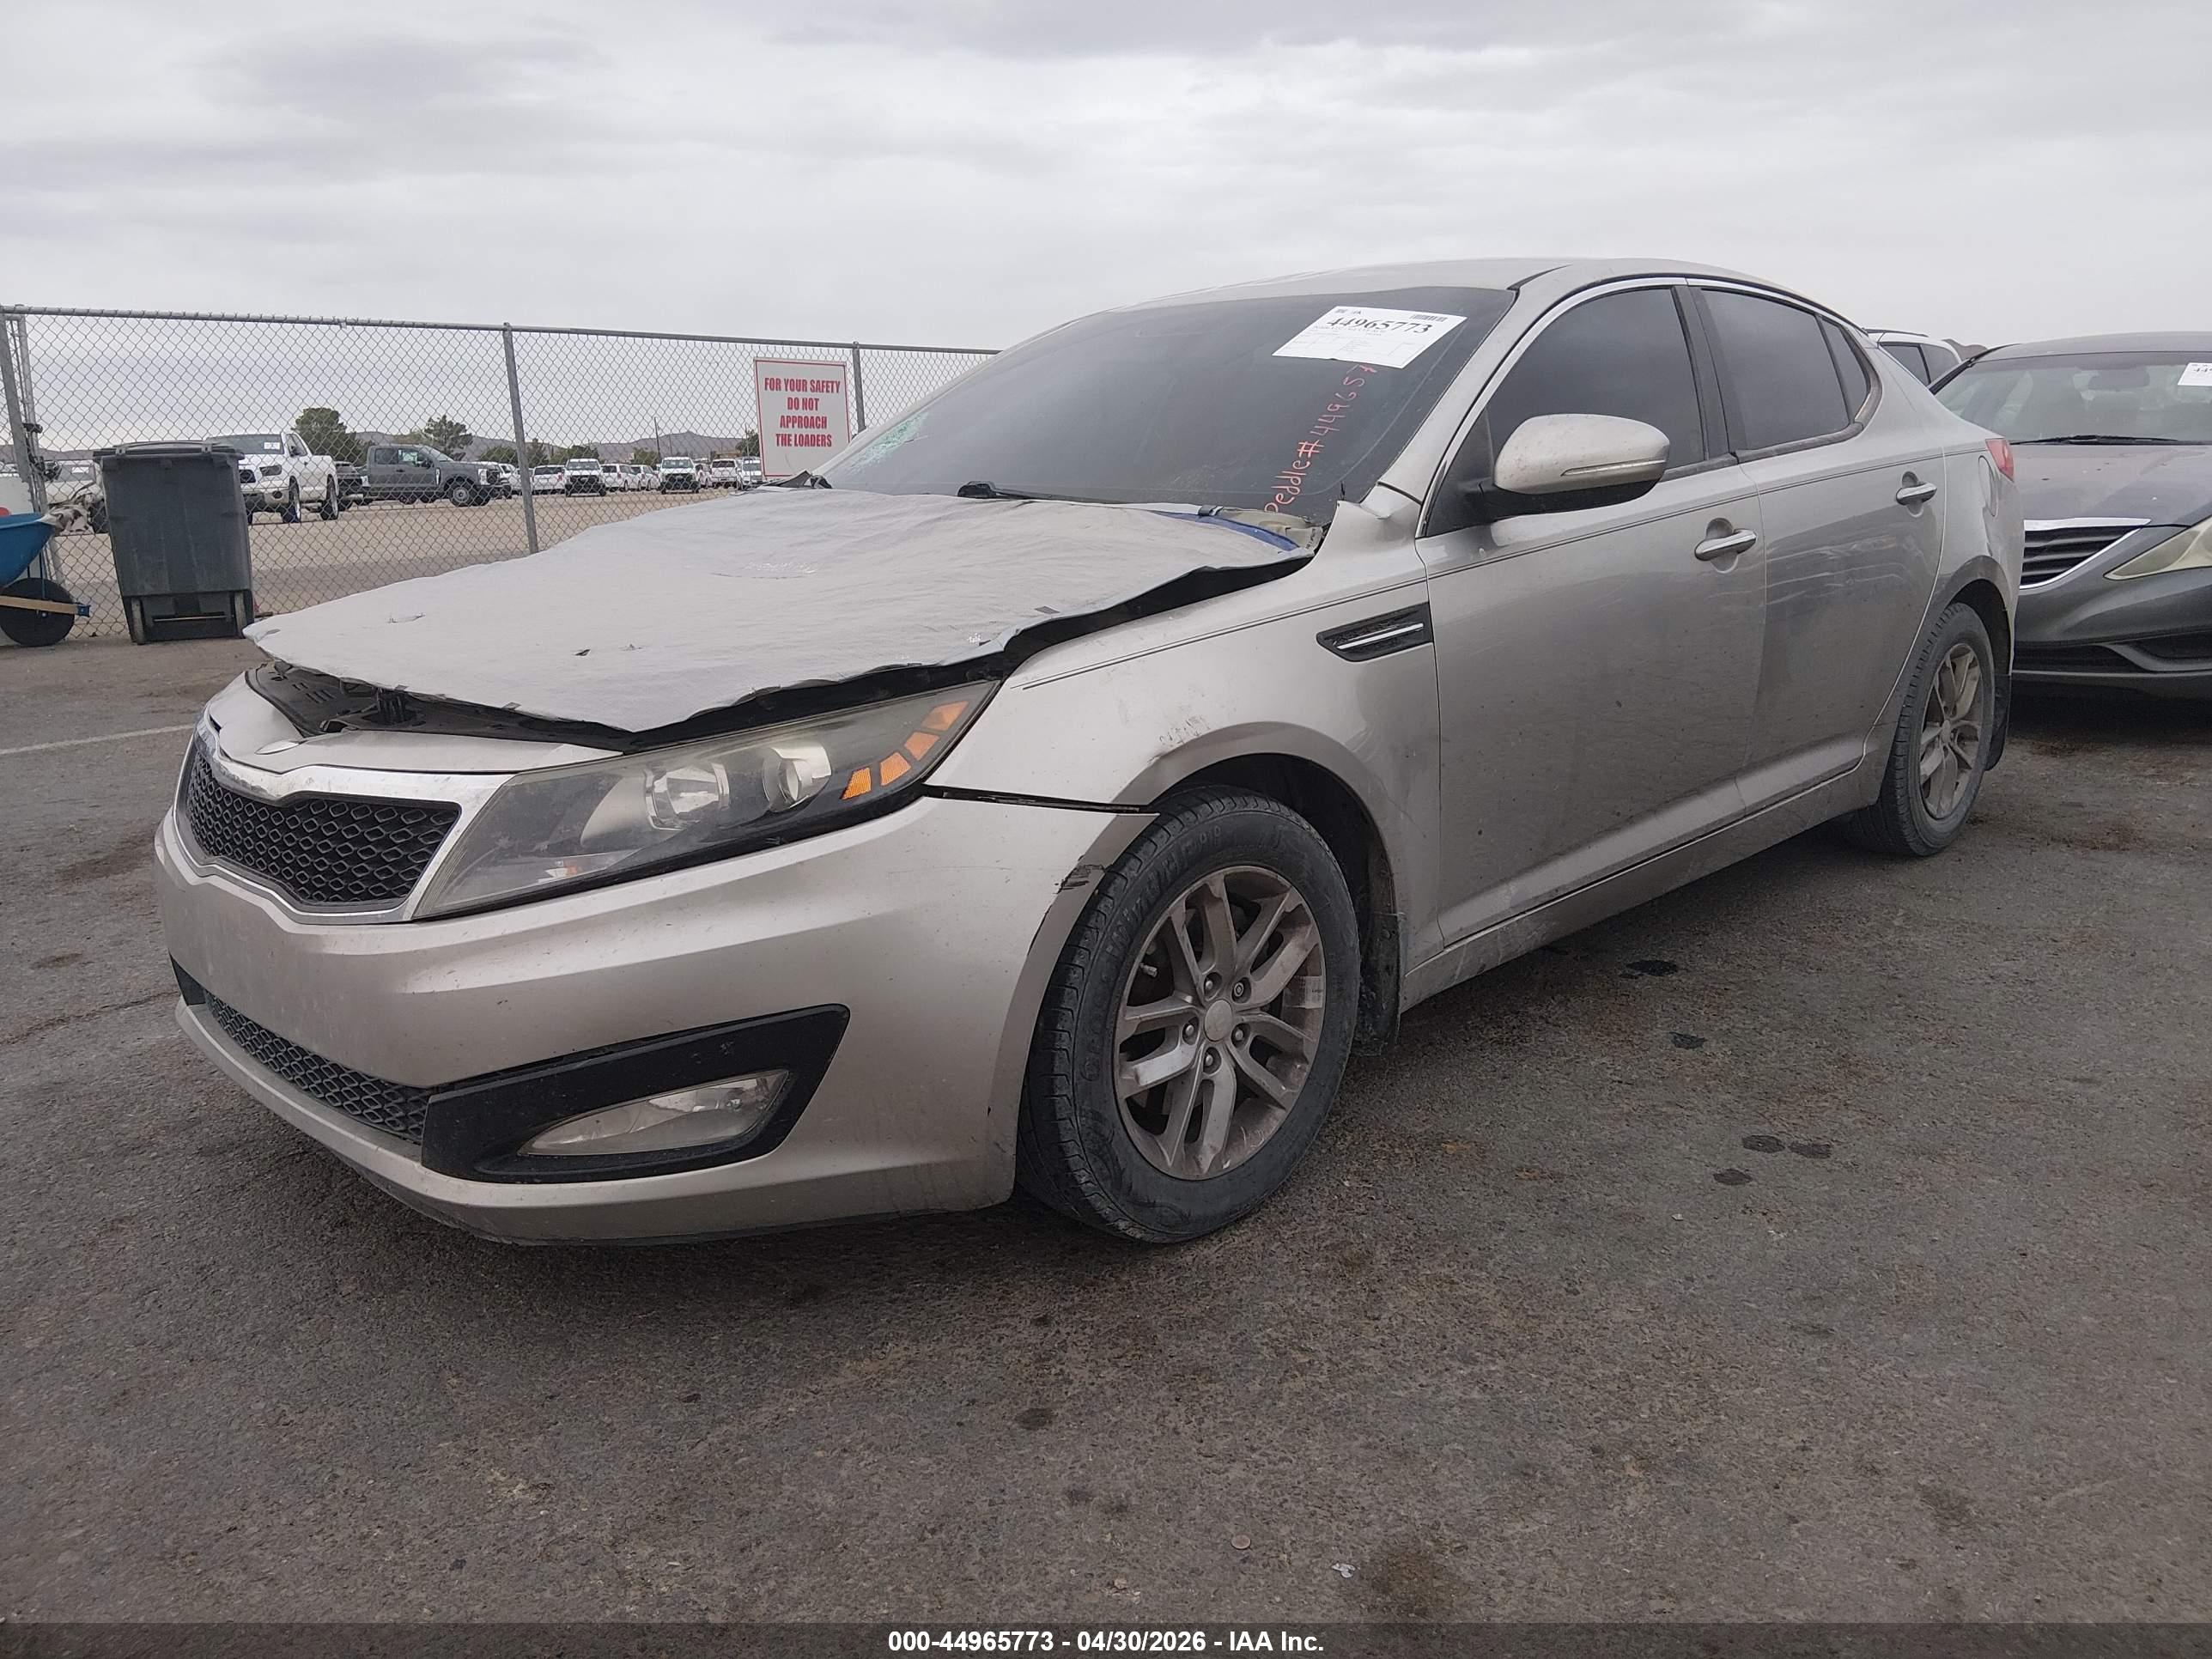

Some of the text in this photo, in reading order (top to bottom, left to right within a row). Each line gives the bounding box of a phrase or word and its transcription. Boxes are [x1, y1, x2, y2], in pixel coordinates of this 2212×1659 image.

[1327, 317, 1433, 334] 44965773
[764, 377, 841, 393] FOR YOUR SAFETY
[787, 397, 820, 411] DO NOT
[780, 415, 828, 429] APPROACH
[775, 433, 833, 447] THE LOADERS
